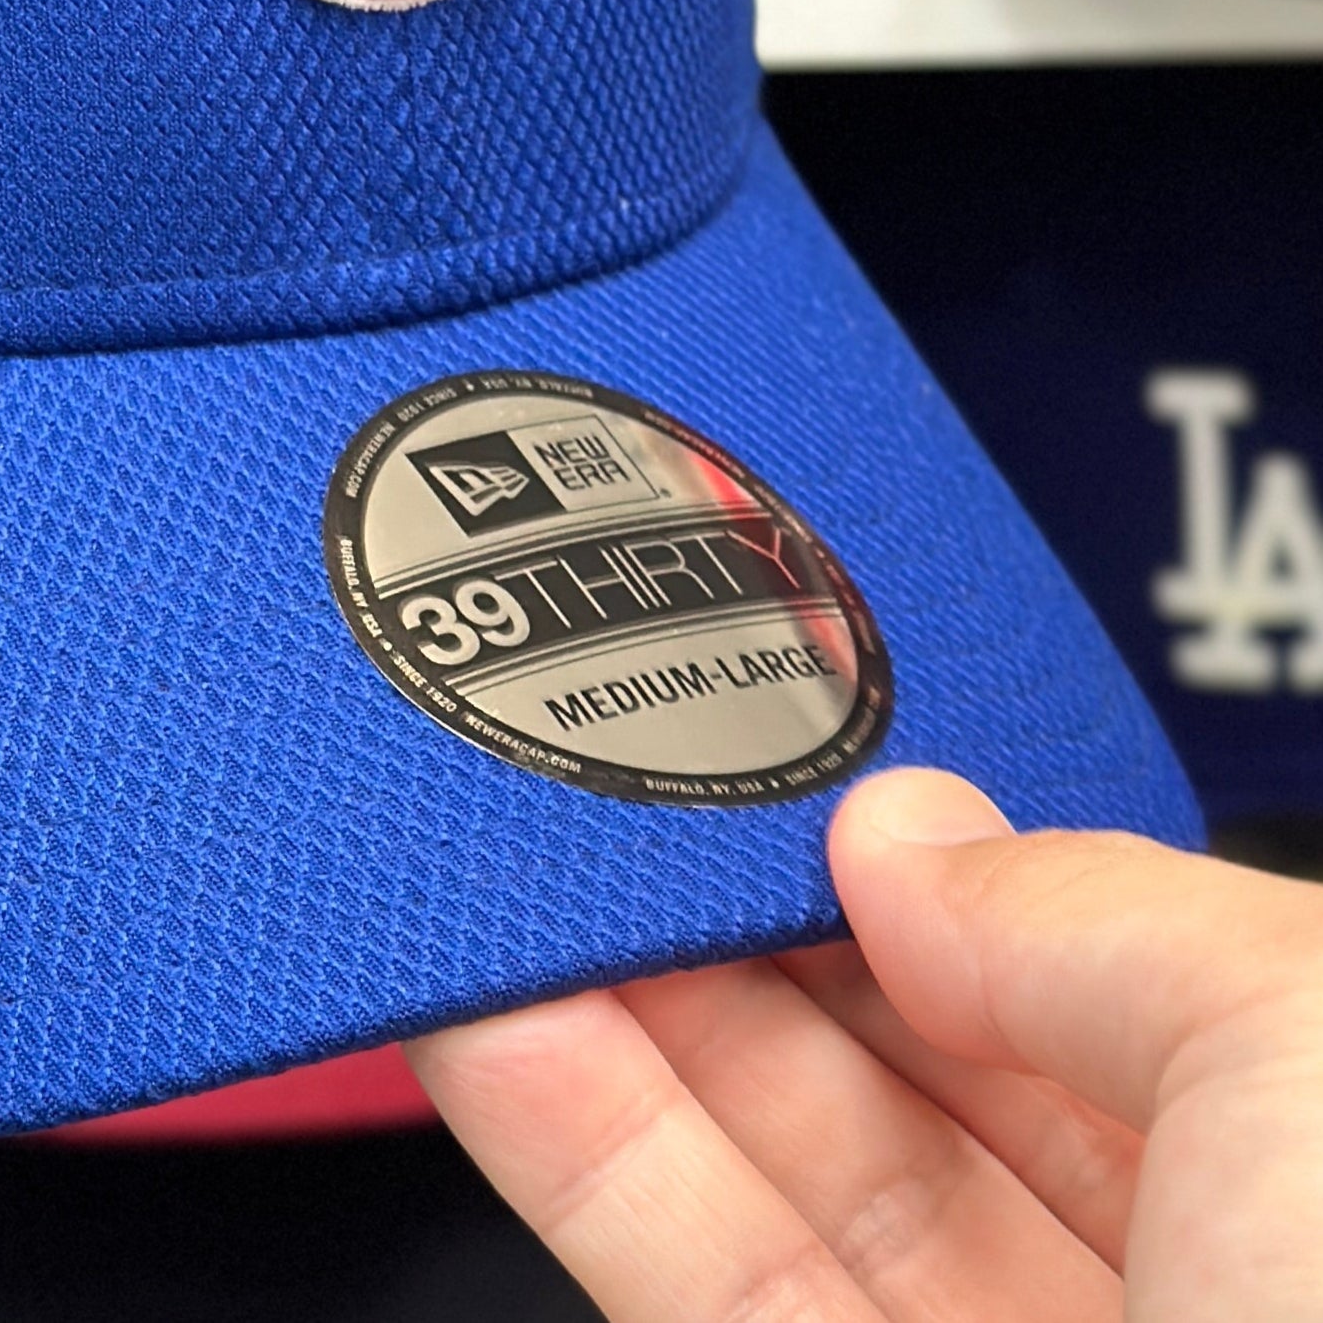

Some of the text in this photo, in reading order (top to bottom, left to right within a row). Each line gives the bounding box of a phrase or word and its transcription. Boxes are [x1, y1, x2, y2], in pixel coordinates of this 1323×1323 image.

[533, 432, 610, 468] NEW
[553, 458, 631, 491] ERA
[1145, 369, 1323, 693] LA
[400, 527, 801, 665] 39THIRTY
[393, 655, 428, 688] SINCE
[426, 685, 458, 713] 1920
[464, 713, 582, 774] NEWERACAP.COM
[544, 645, 836, 732] MEDIUM-LARGE
[737, 779, 765, 794] USA
